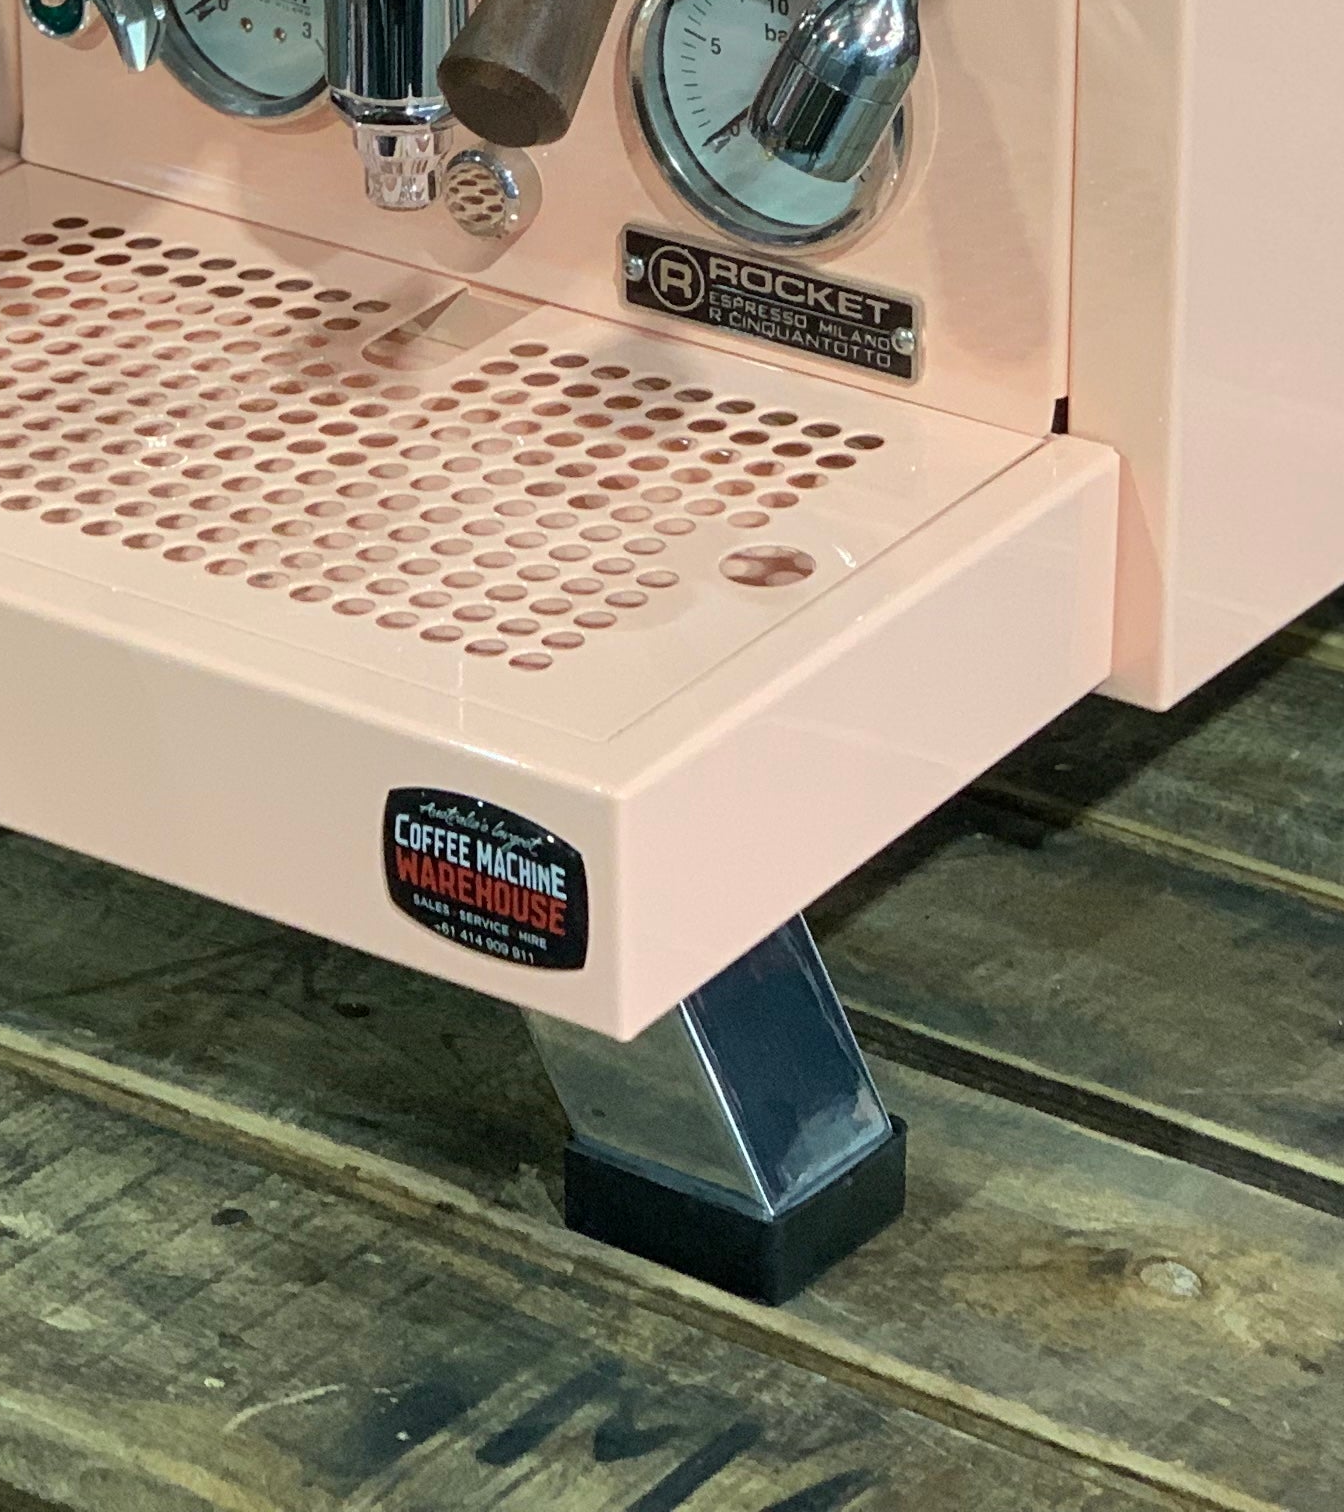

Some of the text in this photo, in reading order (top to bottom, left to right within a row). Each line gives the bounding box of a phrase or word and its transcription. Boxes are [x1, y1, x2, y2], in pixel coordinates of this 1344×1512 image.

[302, 21, 312, 40] 3
[710, 37, 722, 56] 5
[659, 258, 693, 300] R
[709, 256, 891, 325] ROCKET
[709, 291, 891, 352] ESPRESSO MILANO
[709, 306, 891, 369] R CINQUANTOTTO
[394, 813, 568, 901] COFFEE MACHINE
[395, 845, 567, 937] WAREHOUSE
[413, 892, 548, 951] SALES SERVICE HIRE
